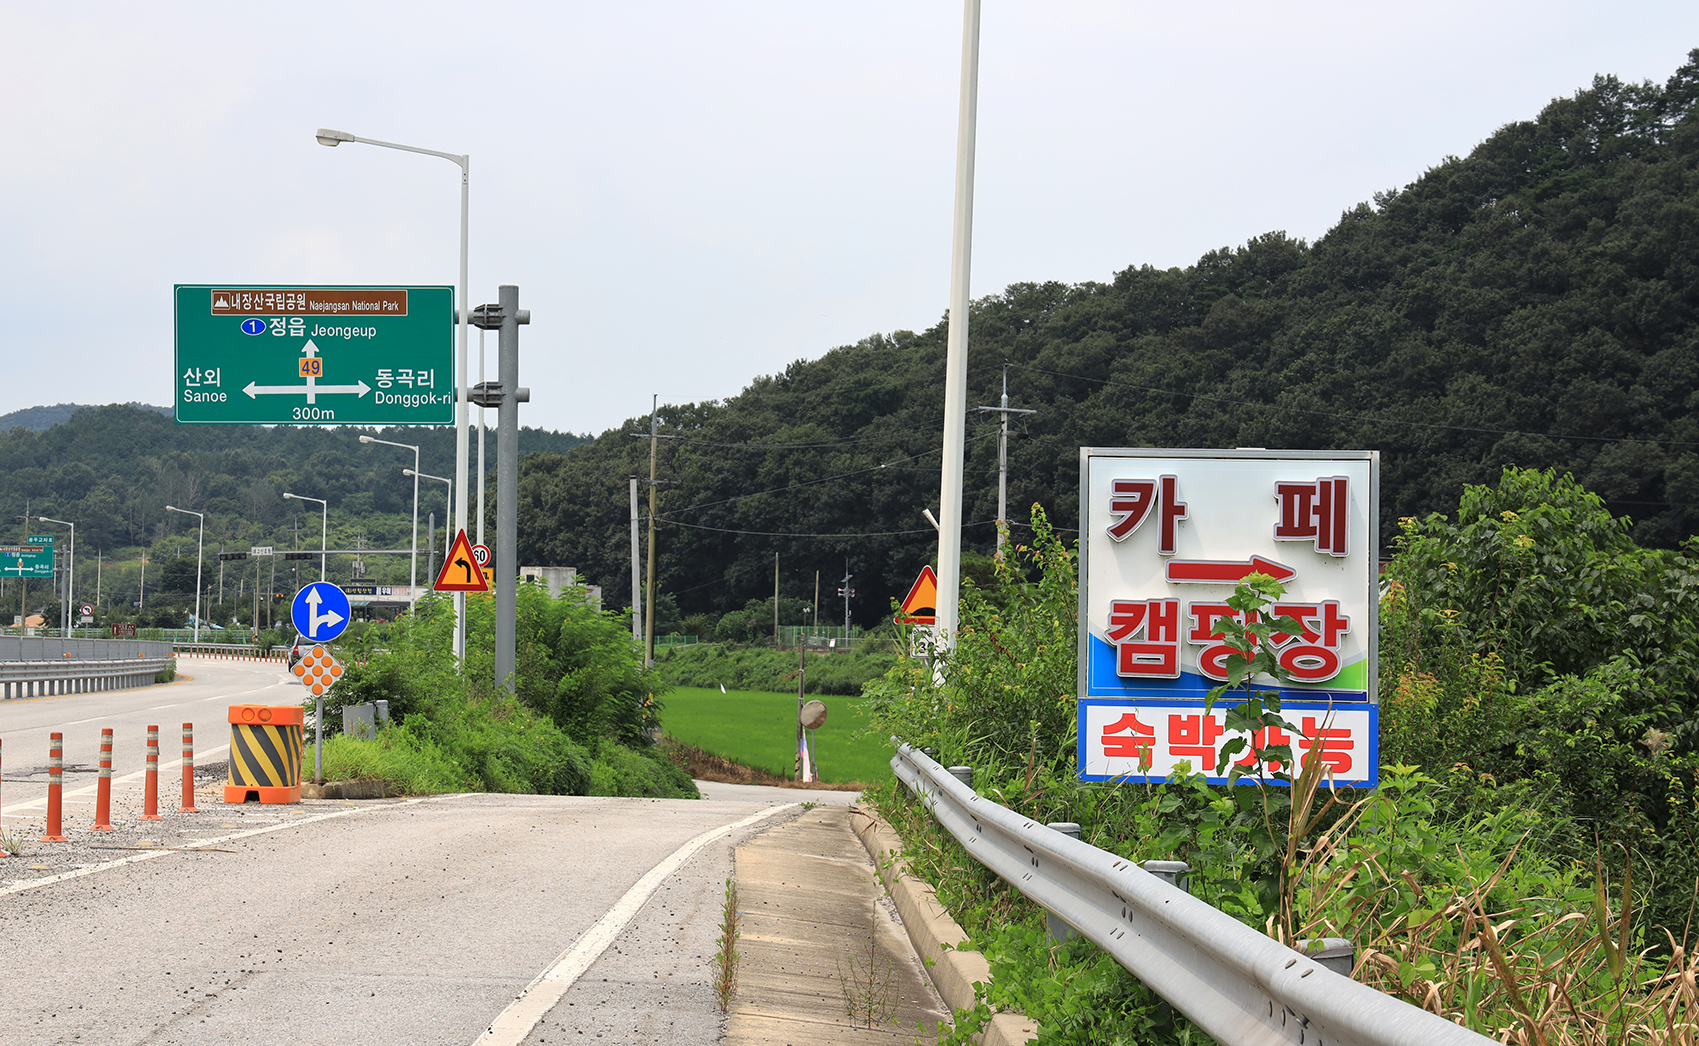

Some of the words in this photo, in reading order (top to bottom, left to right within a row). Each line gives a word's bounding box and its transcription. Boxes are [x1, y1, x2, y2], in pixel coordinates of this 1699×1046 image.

[231, 292, 307, 311] 내장산국립공원
[309, 300, 350, 312] Naejangsan
[352, 300, 381, 311] National
[382, 300, 399, 311] Park
[249, 321, 257, 333] 1
[269, 317, 307, 337] 정읍
[310, 323, 377, 339] Jeongeup
[301, 360, 320, 375] 49
[183, 367, 221, 387] 산외
[375, 368, 435, 389] 동곡리
[183, 389, 227, 403] Sanoe
[375, 391, 451, 408] Donggok-ri
[292, 407, 335, 420] 300m
[473, 550, 486, 562] 60
[1104, 597, 1351, 683] 캠핑장
